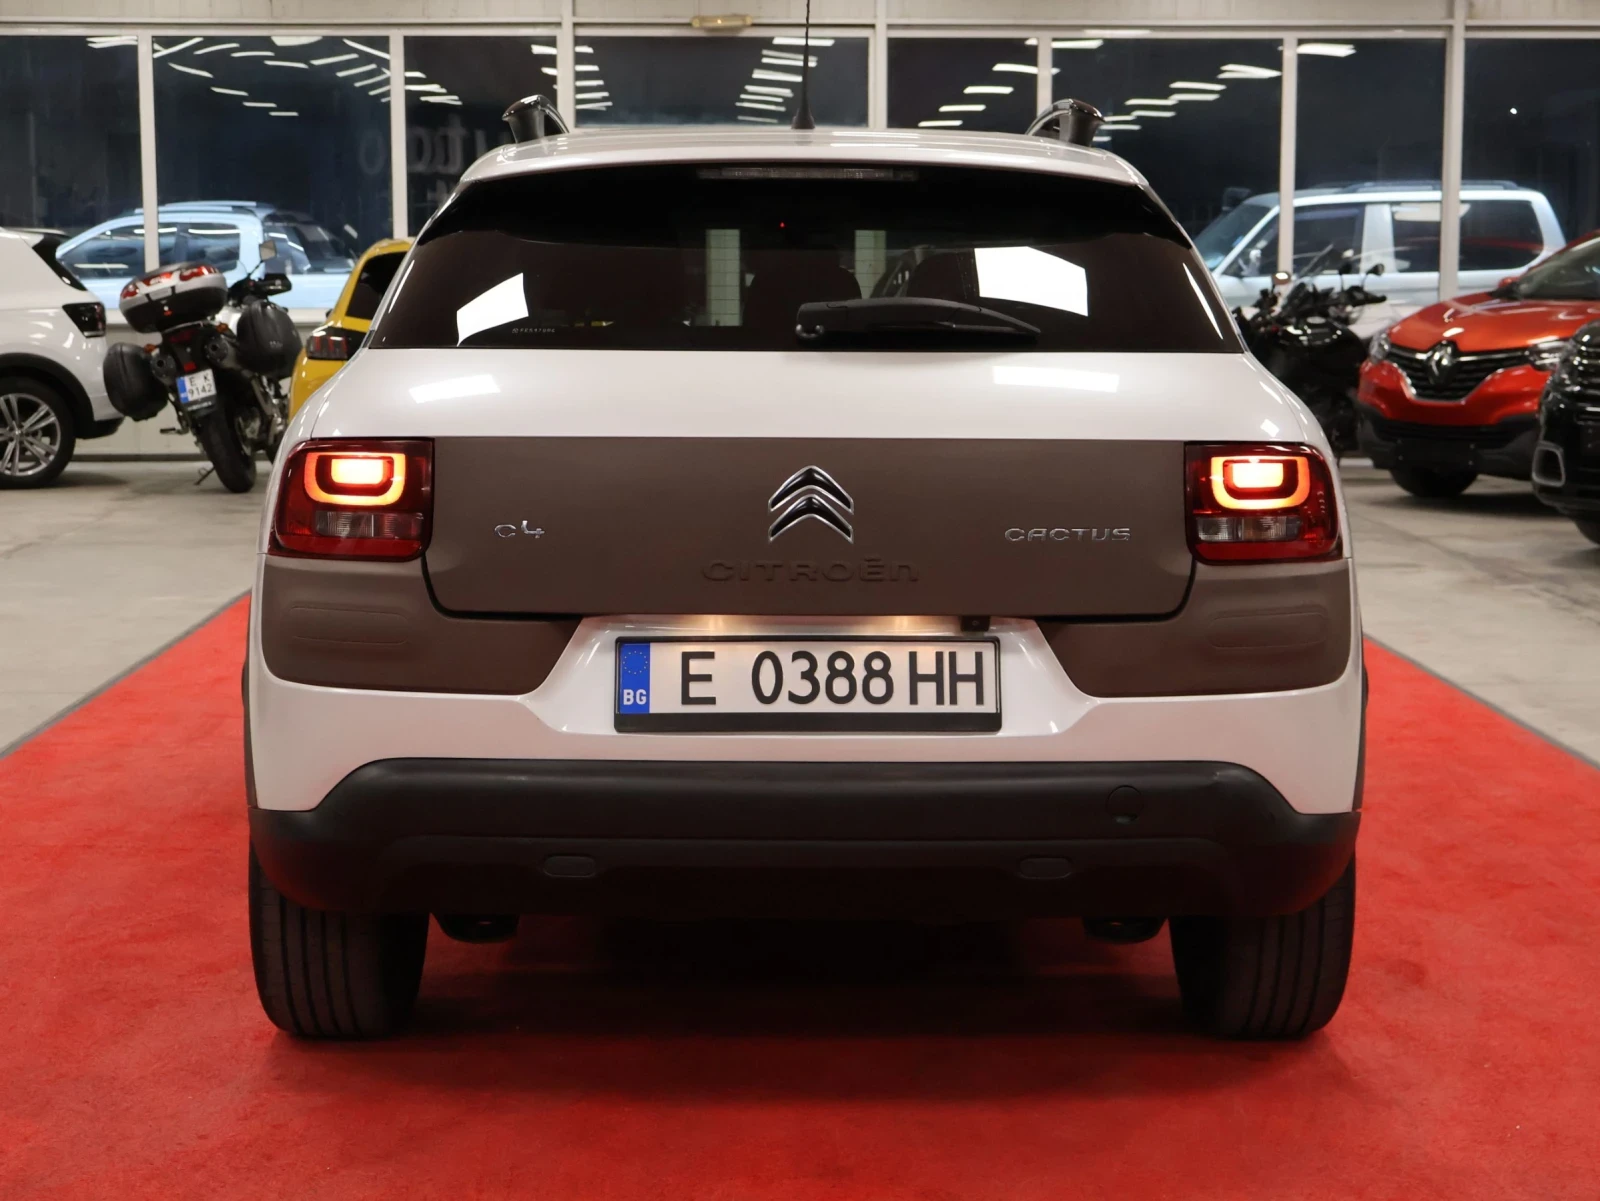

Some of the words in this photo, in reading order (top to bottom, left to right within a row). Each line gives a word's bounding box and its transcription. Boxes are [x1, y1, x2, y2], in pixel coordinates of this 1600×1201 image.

[188, 383, 213, 397] 9142
[494, 520, 545, 539] C4
[1004, 528, 1131, 542] CACTUS
[681, 651, 716, 705] E
[751, 650, 894, 705] 0388
[909, 651, 984, 705] HH
[623, 689, 647, 705] BG
